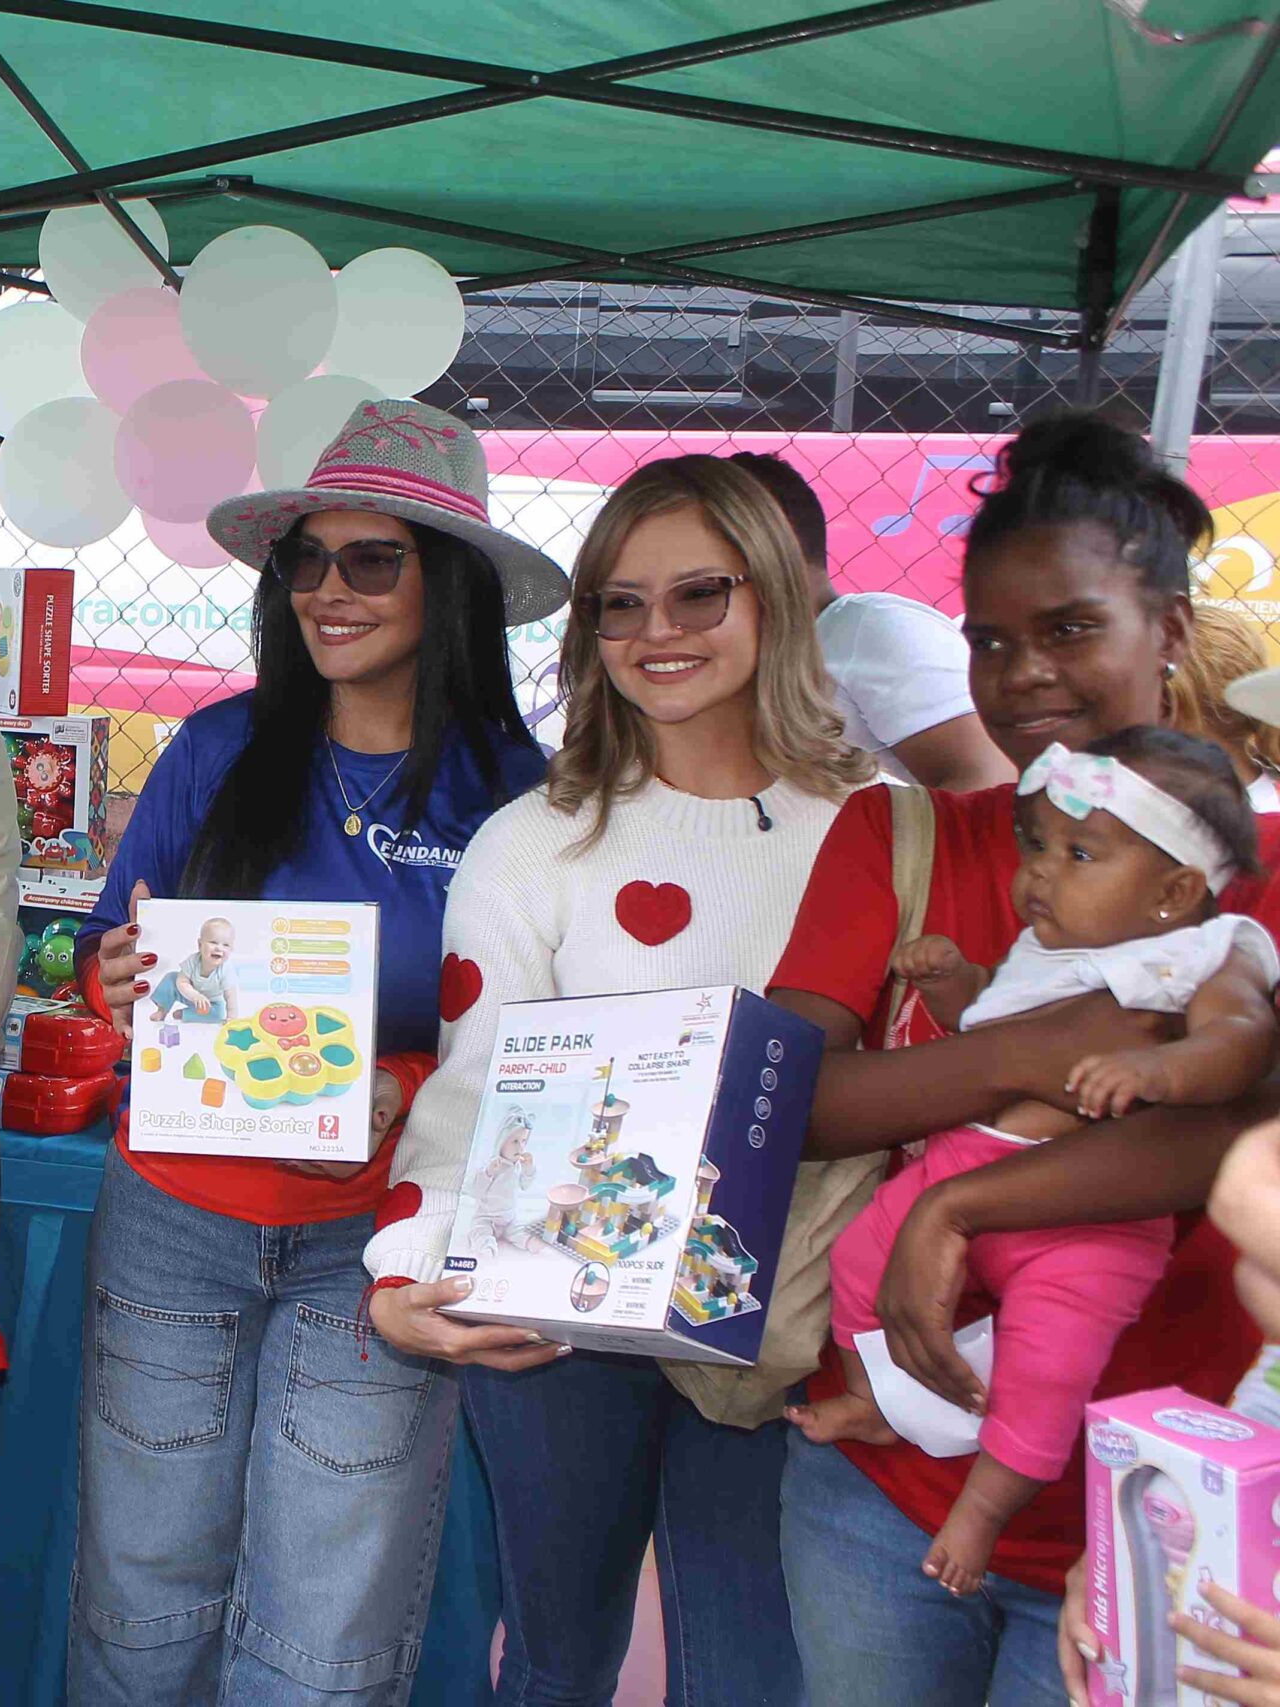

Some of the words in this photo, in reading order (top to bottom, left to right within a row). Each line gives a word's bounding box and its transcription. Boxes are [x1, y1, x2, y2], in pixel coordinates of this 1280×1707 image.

[45, 595, 54, 626] PUZZLE
[43, 626, 53, 657] SHAPE
[42, 660, 51, 694] SORTER
[380, 841, 465, 862] FUNDANI
[504, 1036, 547, 1053] SLIDE
[551, 1033, 594, 1051] PARK
[500, 1081, 542, 1091] INTERACTION
[139, 1109, 196, 1129] Puzzle
[199, 1112, 257, 1135] Shape
[259, 1115, 314, 1134] Sorter
[323, 1116, 335, 1131] 9
[449, 1259, 475, 1269] 3+AGES
[1093, 1484, 1111, 1594] Microphone
[1093, 1594, 1109, 1636] Kids
